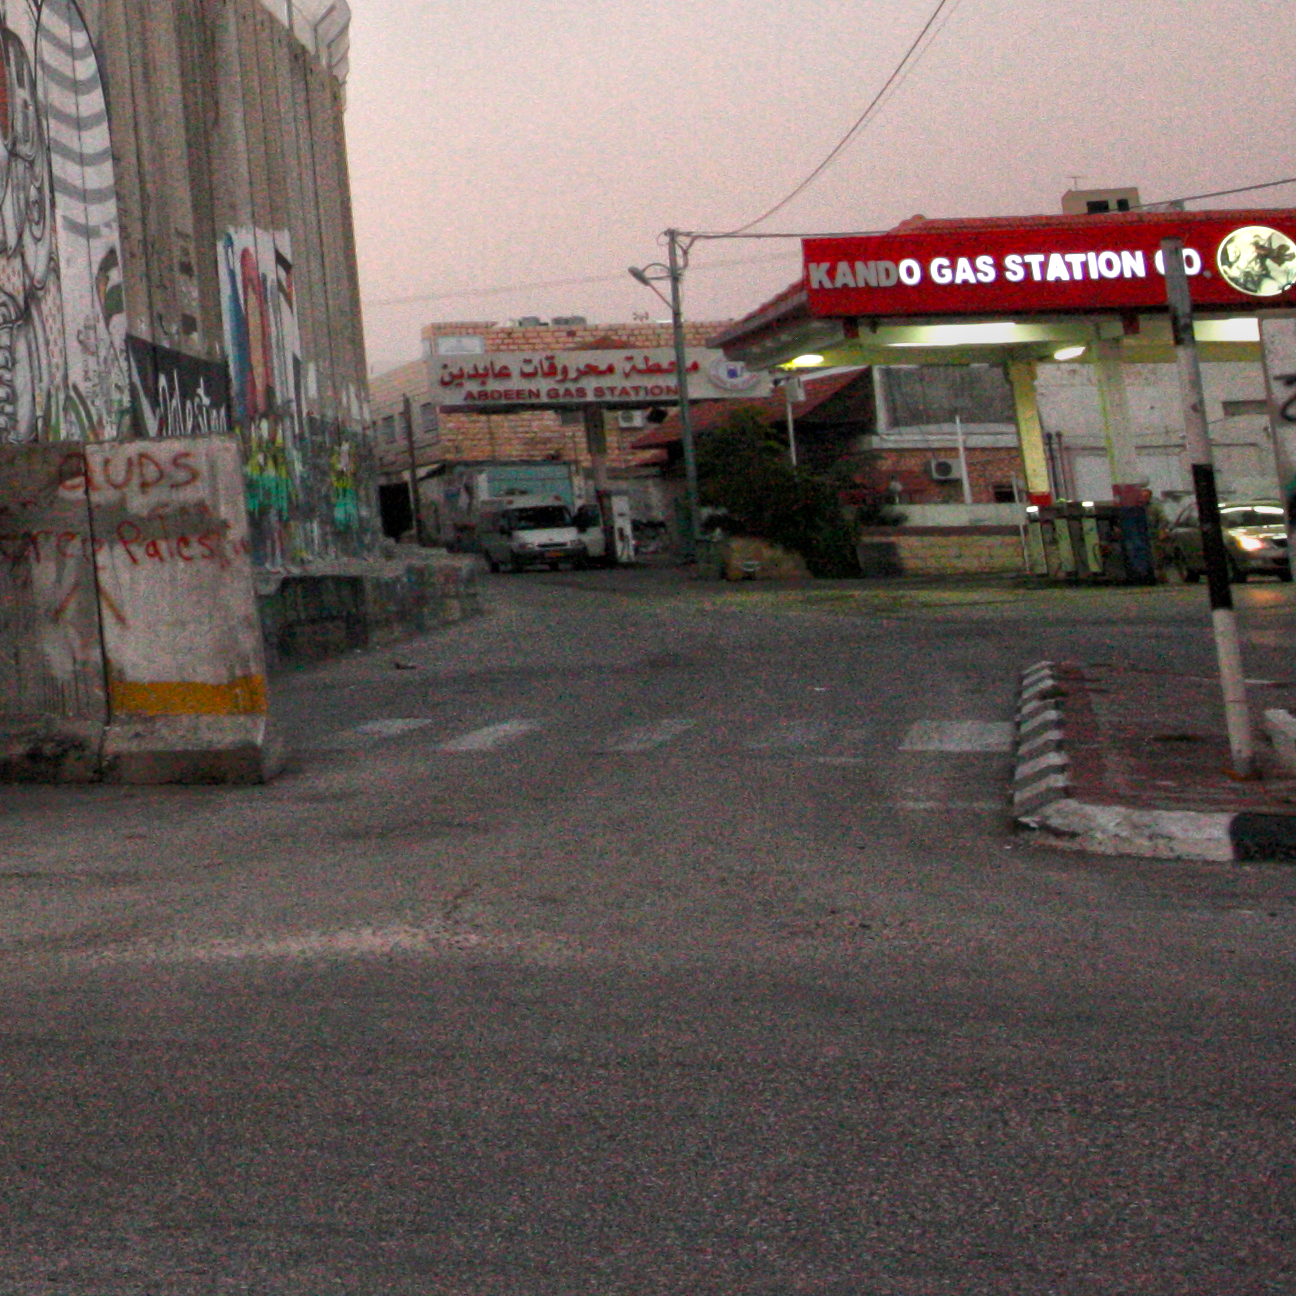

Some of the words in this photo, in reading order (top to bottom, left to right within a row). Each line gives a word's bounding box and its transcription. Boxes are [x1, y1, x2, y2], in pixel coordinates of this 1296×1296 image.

[809, 257, 923, 290] KANDO
[929, 254, 998, 286] GAS
[1003, 249, 1146, 283] STATION
[519, 354, 615, 384] محروقات
[463, 387, 542, 402] ABDEEN
[546, 386, 591, 400] GAS
[593, 383, 680, 398] STATION
